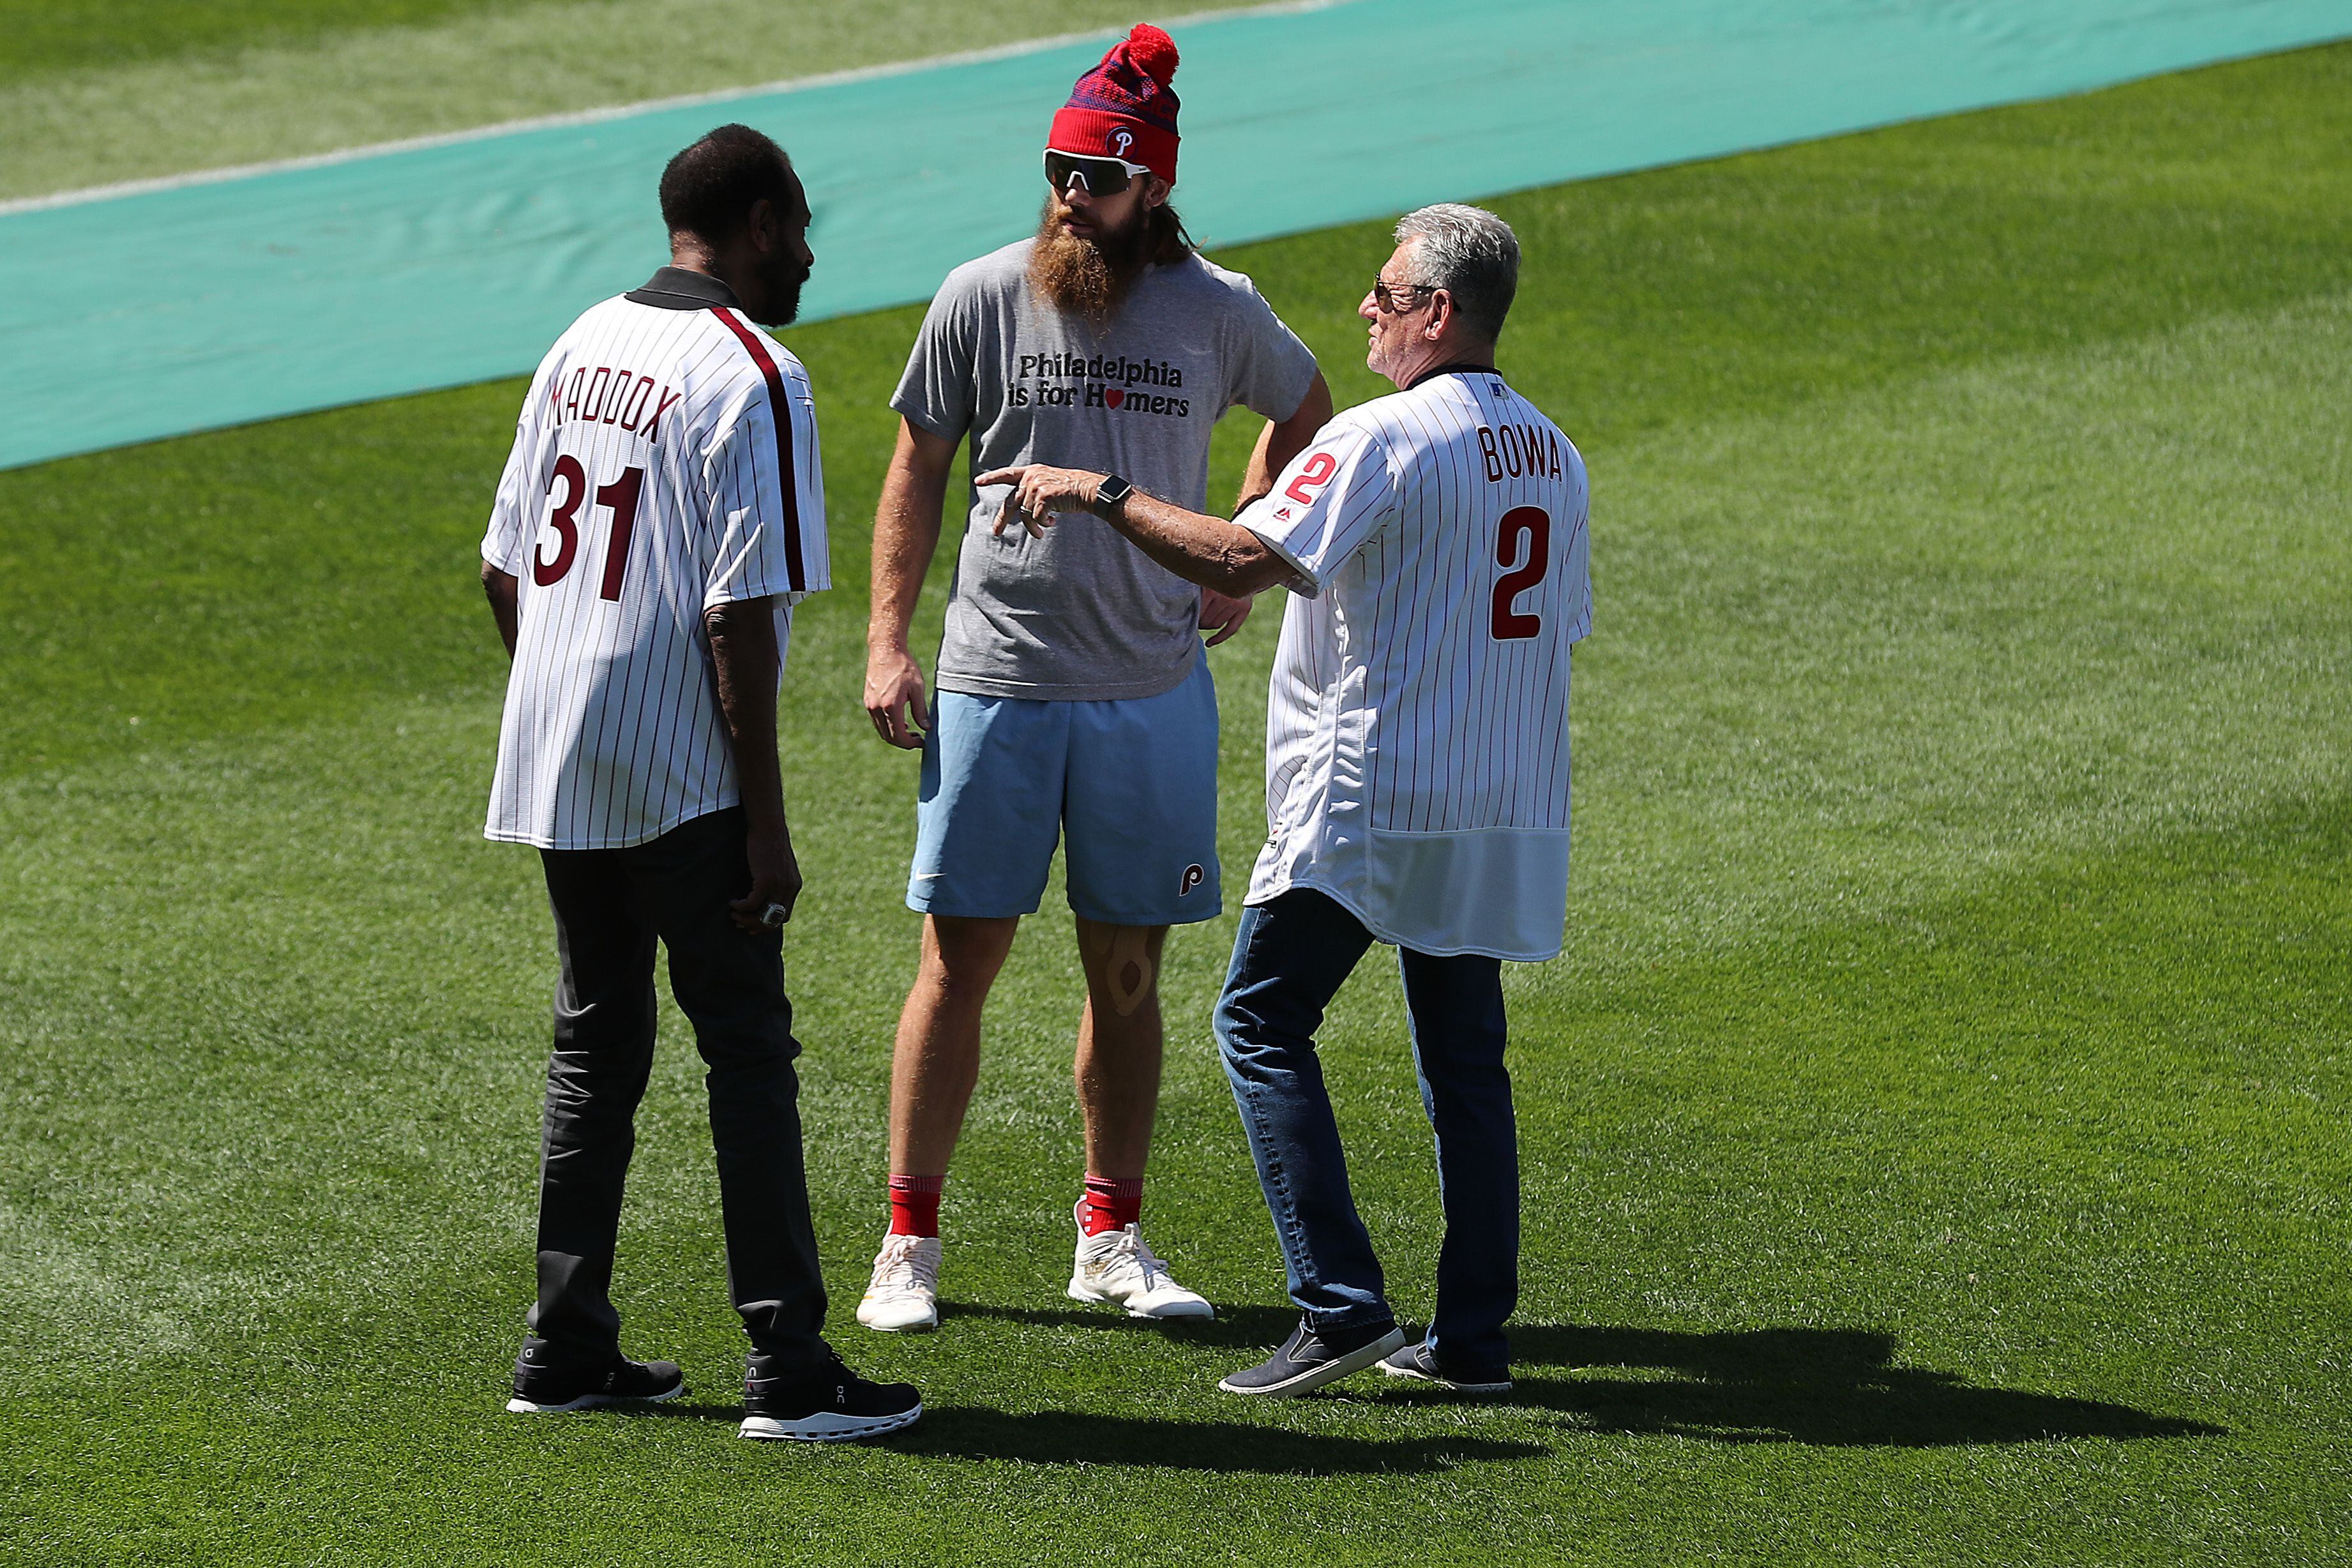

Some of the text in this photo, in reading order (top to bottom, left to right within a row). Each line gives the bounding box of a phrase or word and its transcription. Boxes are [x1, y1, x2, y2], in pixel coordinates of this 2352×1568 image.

[1115, 132, 1133, 156] P
[1008, 382, 1028, 407] is
[1037, 381, 1078, 406] for
[1020, 352, 1182, 388] Philadelphia
[547, 366, 682, 444] MADDOX
[1285, 452, 1338, 506] 2
[1478, 426, 1562, 483] BOWA
[534, 454, 645, 602] 31
[1491, 506, 1551, 639] 2
[1179, 863, 1204, 896] P
